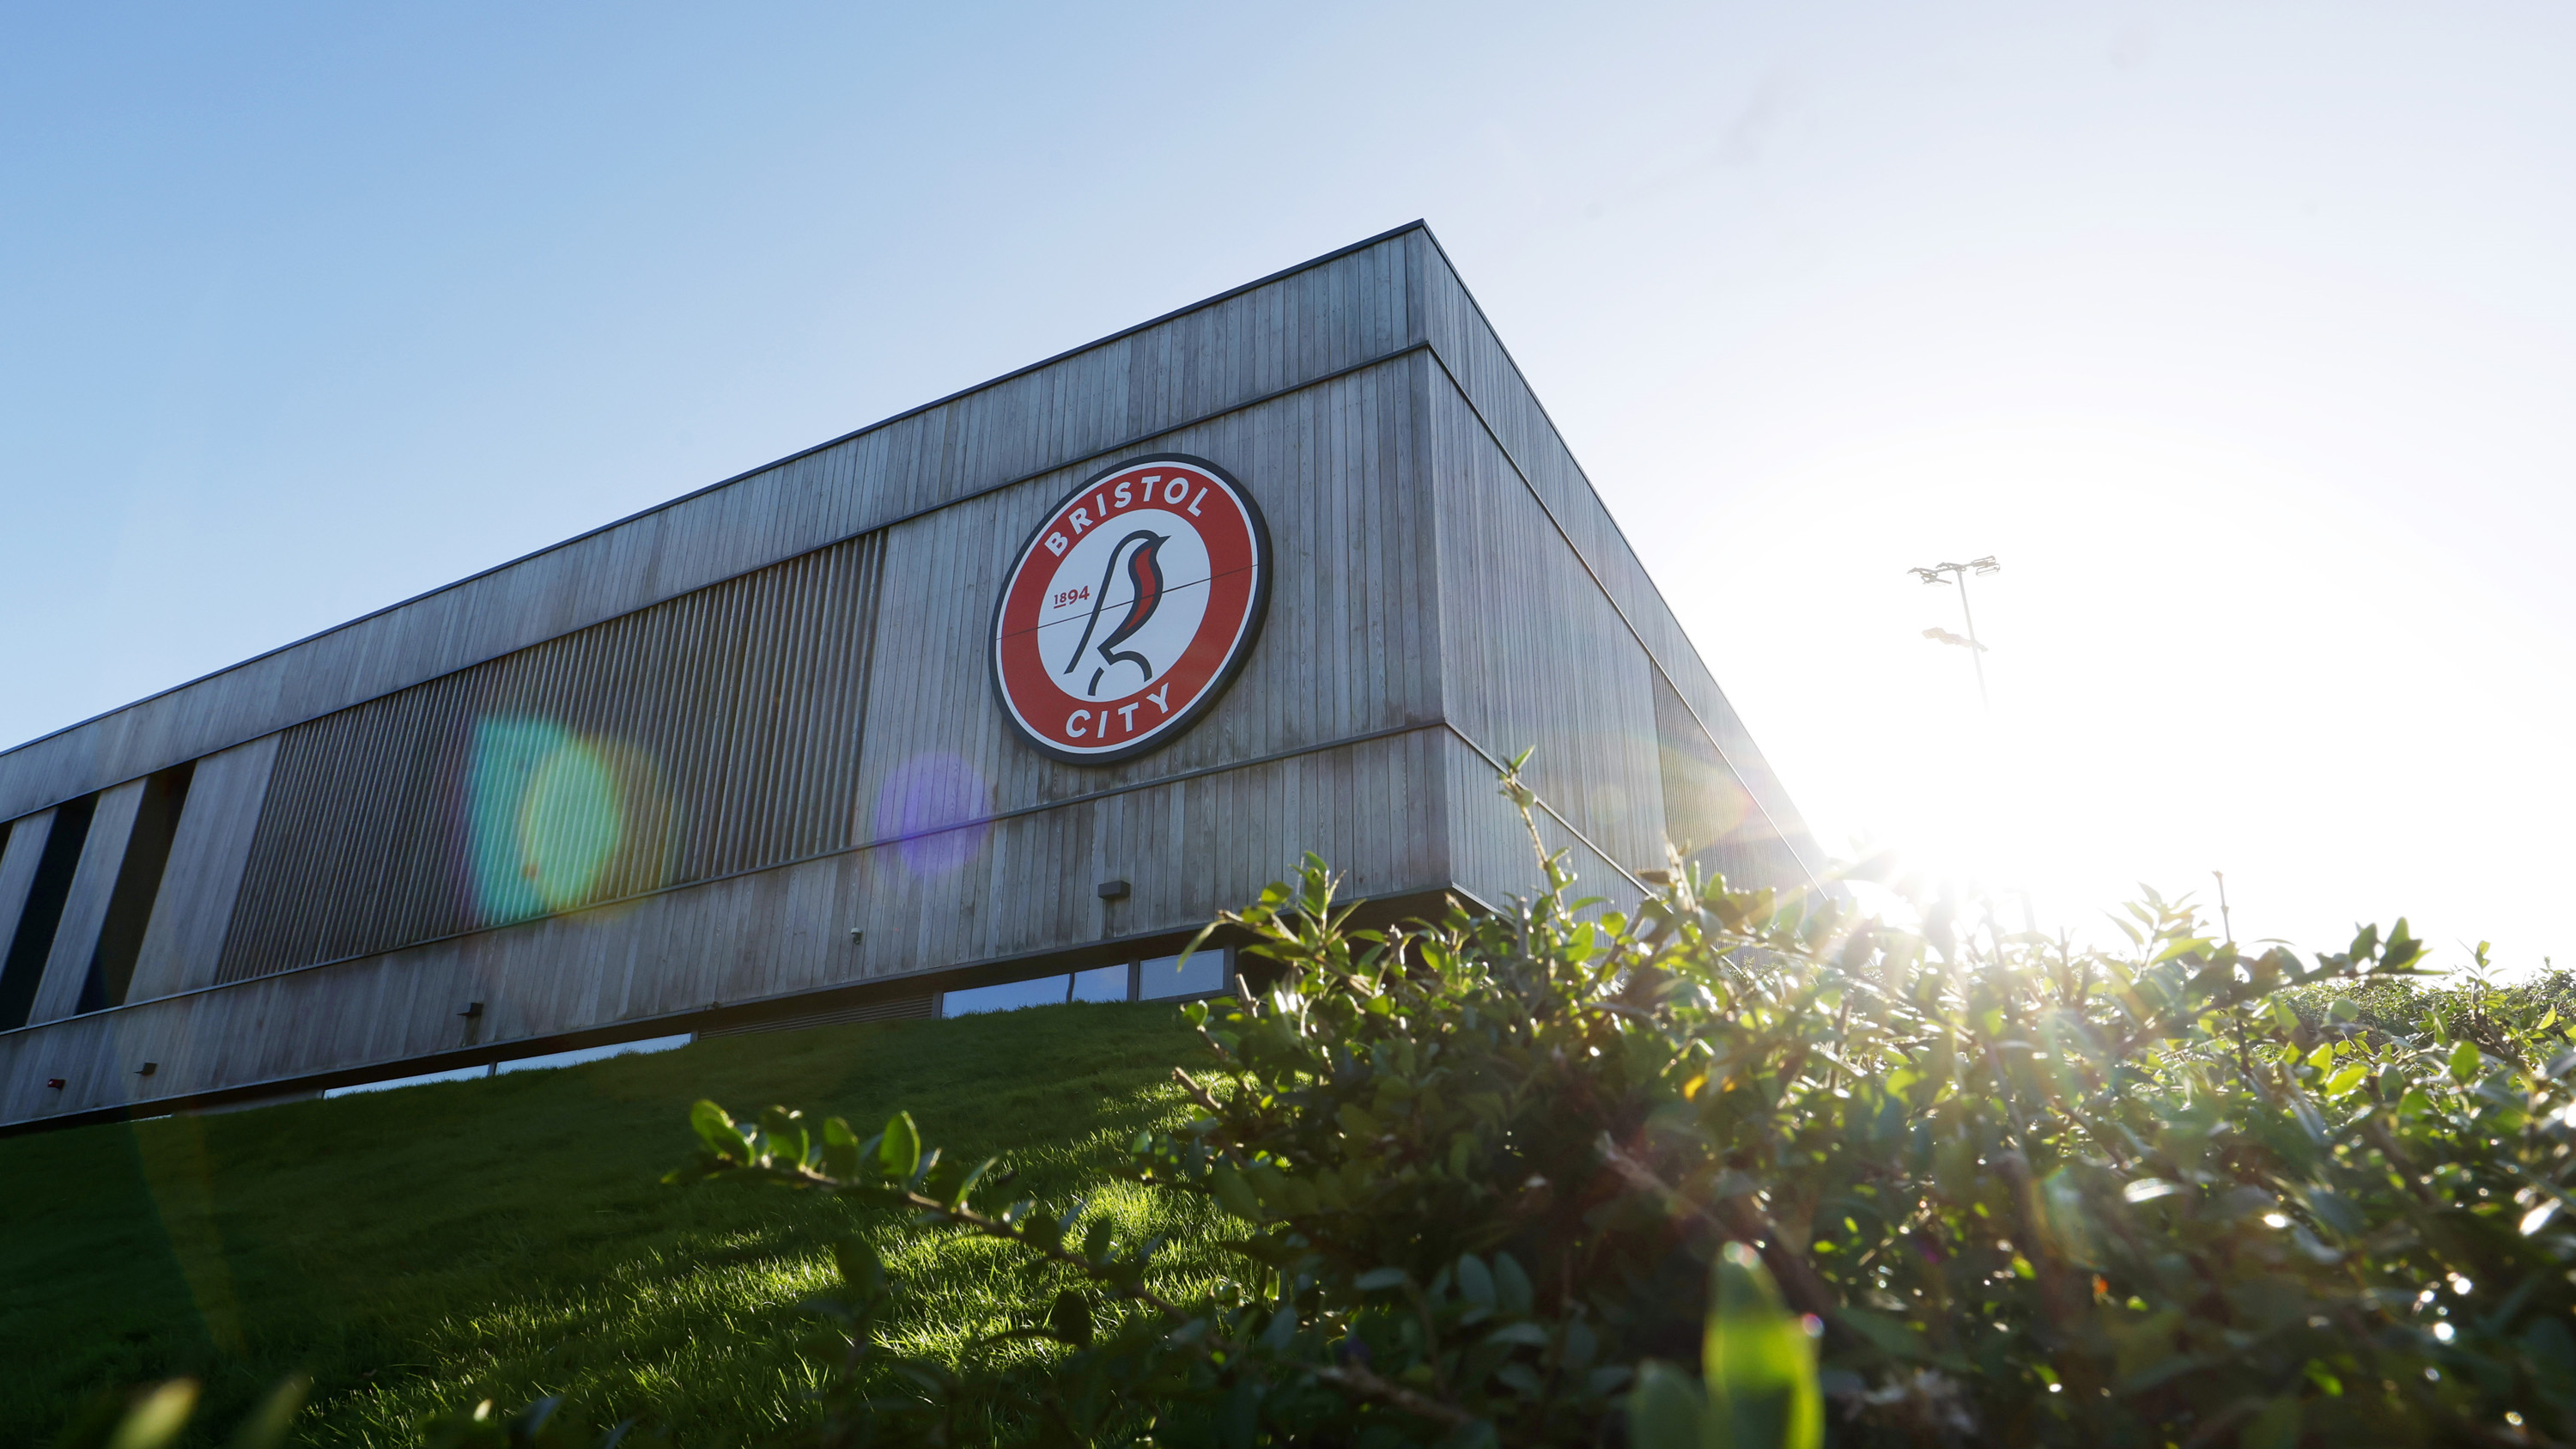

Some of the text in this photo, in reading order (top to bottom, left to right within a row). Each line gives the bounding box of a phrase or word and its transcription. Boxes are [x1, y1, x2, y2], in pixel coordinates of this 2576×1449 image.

[1044, 475, 1208, 557] BRISTOL
[1053, 585, 1091, 609] 1894
[1066, 682, 1170, 739] CITY
